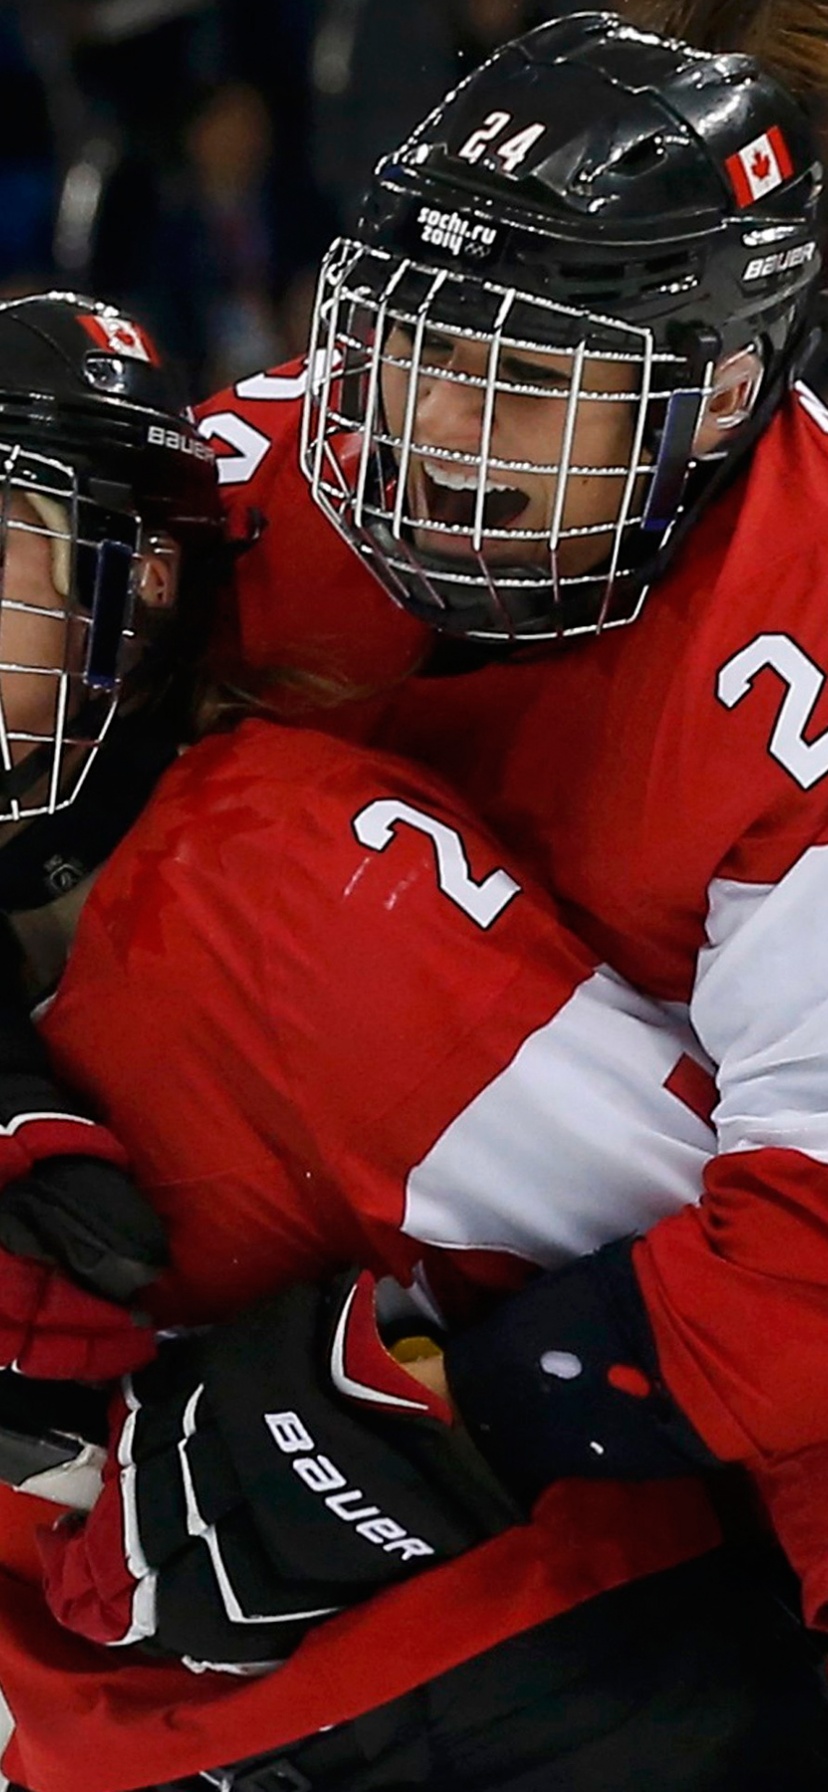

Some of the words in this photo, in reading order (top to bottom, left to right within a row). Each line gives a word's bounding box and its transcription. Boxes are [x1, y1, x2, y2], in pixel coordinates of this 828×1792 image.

[458, 110, 547, 174] 24
[417, 206, 497, 245] sochi.ru
[421, 224, 463, 256] 2014
[715, 632, 828, 790] 2
[351, 797, 521, 930] 2
